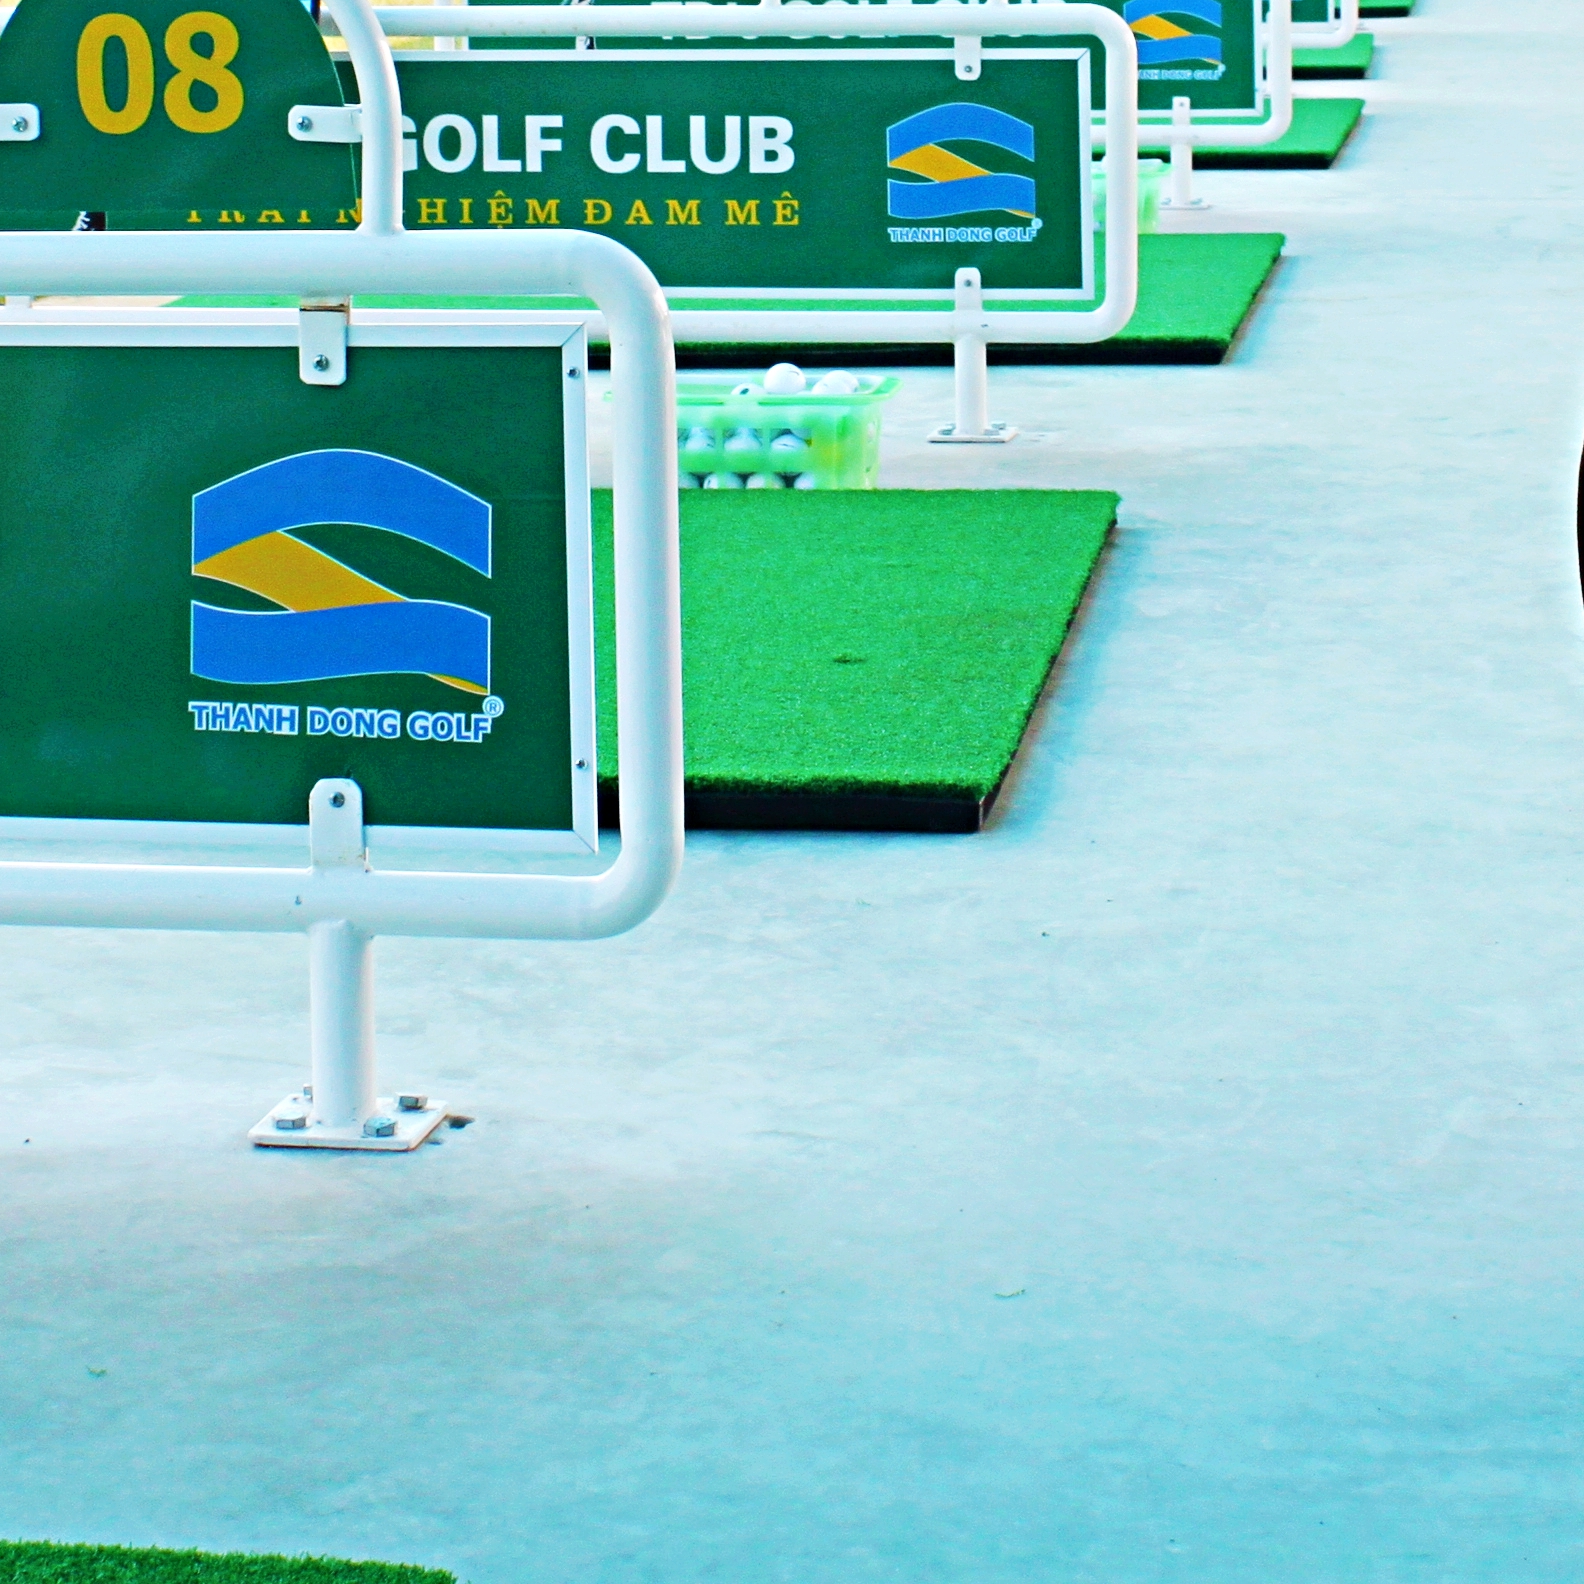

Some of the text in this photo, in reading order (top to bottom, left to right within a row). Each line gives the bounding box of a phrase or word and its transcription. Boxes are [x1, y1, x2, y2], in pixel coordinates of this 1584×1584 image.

[76, 11, 245, 135] 08
[589, 115, 796, 176] CLUB
[583, 198, 702, 226] ĐAM
[726, 189, 800, 227] MÊ
[888, 227, 943, 242] THANH
[946, 228, 992, 243] DONG
[188, 701, 300, 736] THANH
[307, 706, 401, 739] DONG
